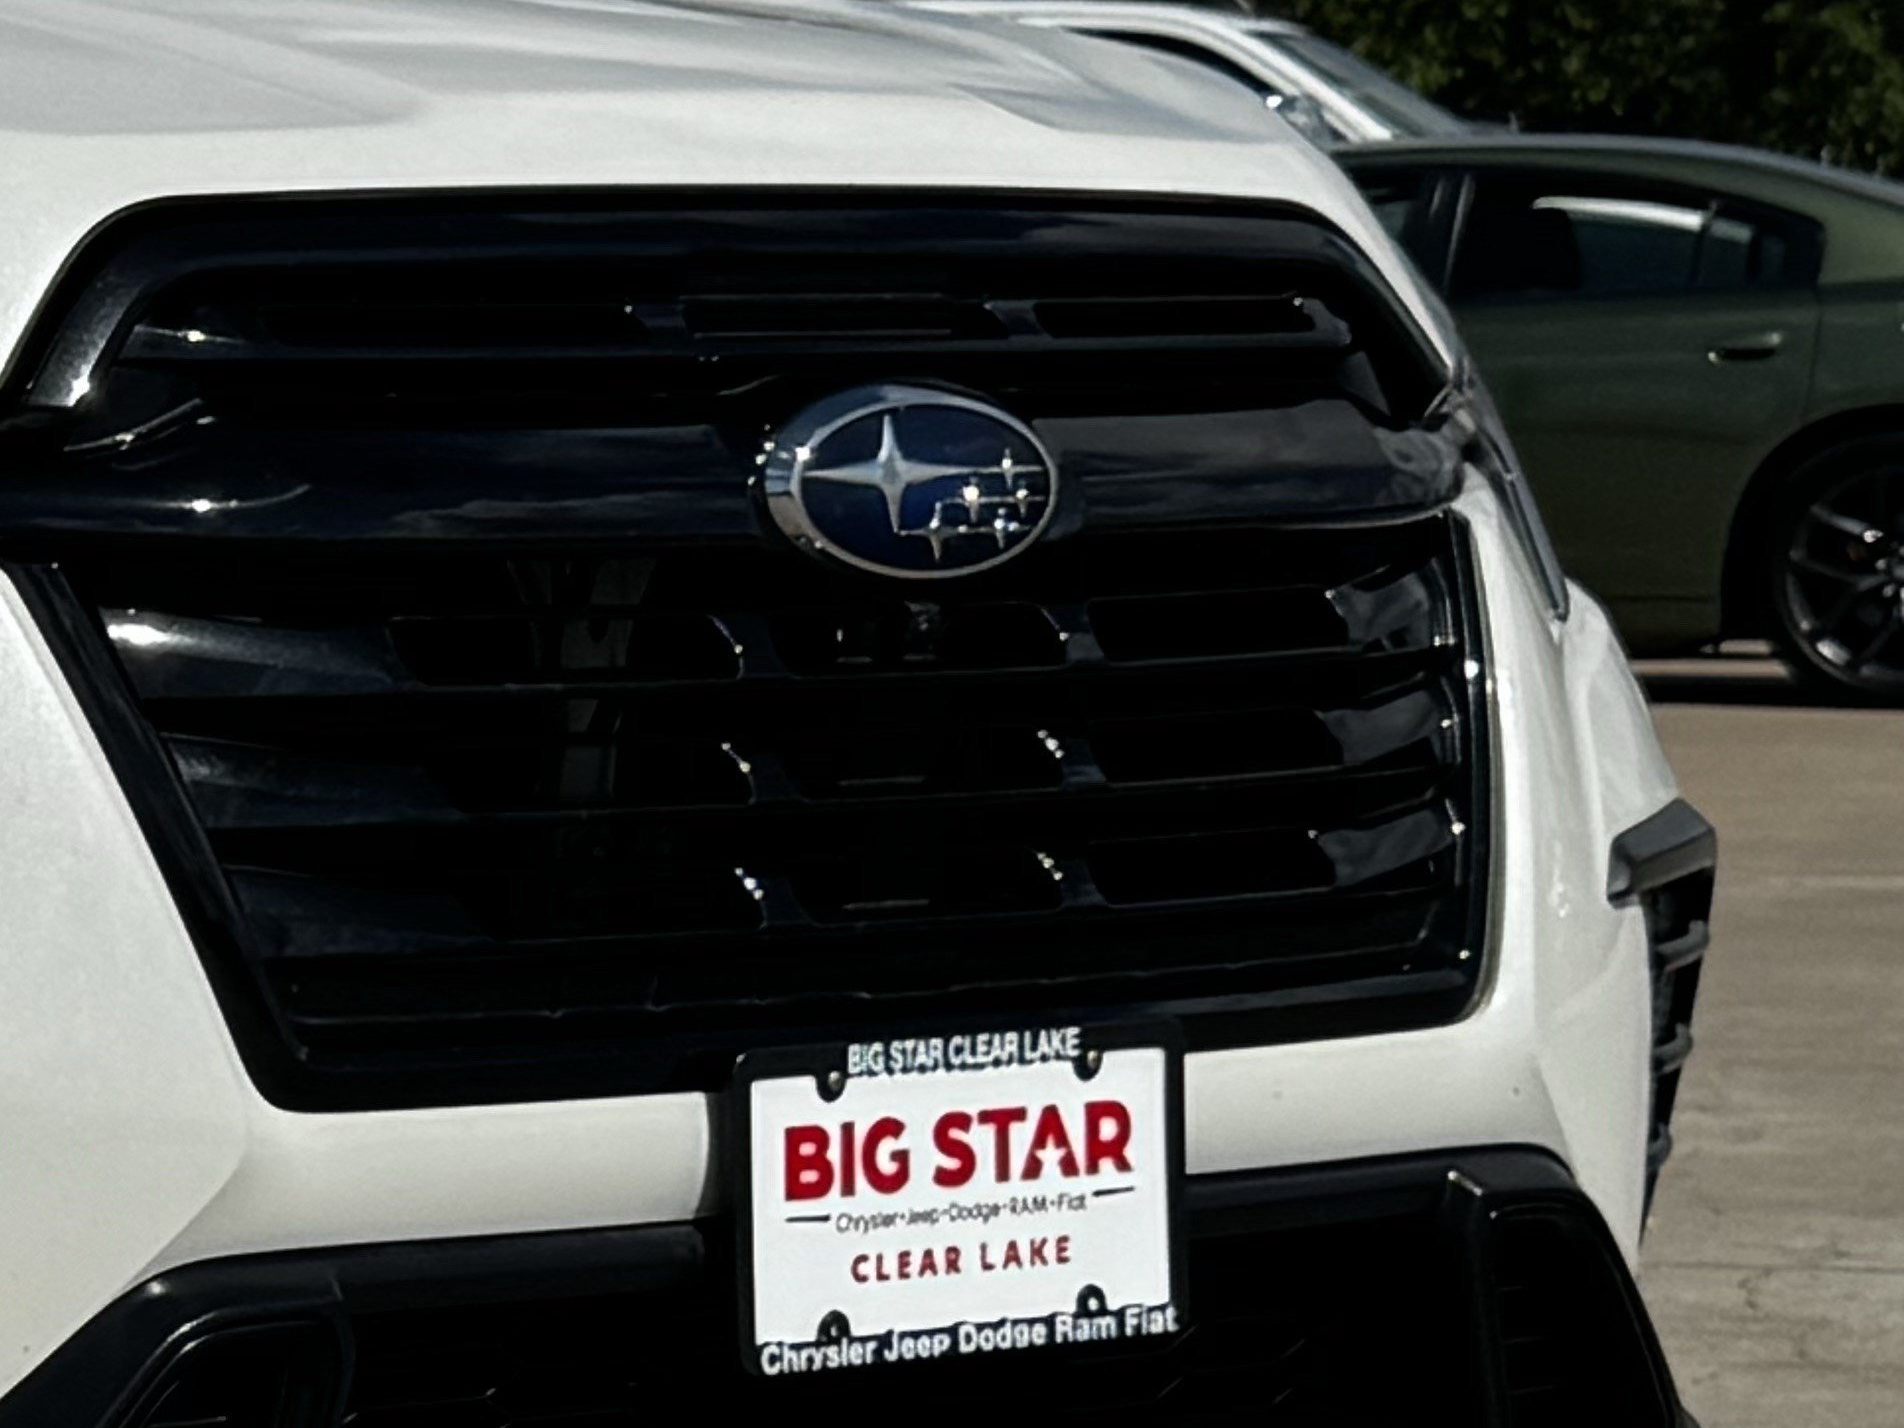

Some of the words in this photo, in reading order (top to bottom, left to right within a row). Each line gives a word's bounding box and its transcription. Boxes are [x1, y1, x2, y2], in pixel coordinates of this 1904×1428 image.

[847, 1041, 885, 1074] BIG
[889, 1037, 943, 1071] STAR
[948, 1031, 1019, 1065] CLEAR
[1023, 1026, 1081, 1060] LAKE
[784, 1116, 910, 1202] BIG
[932, 1099, 1133, 1189] STAR
[850, 1245, 962, 1283] CLEAR
[980, 1234, 1073, 1271] LAKE
[760, 1339, 877, 1375] Chrysler
[884, 1329, 951, 1363] Jeep
[958, 1320, 1047, 1353] Dodge
[1054, 1313, 1118, 1343] Ram
[1124, 1305, 1179, 1335] Fiat
